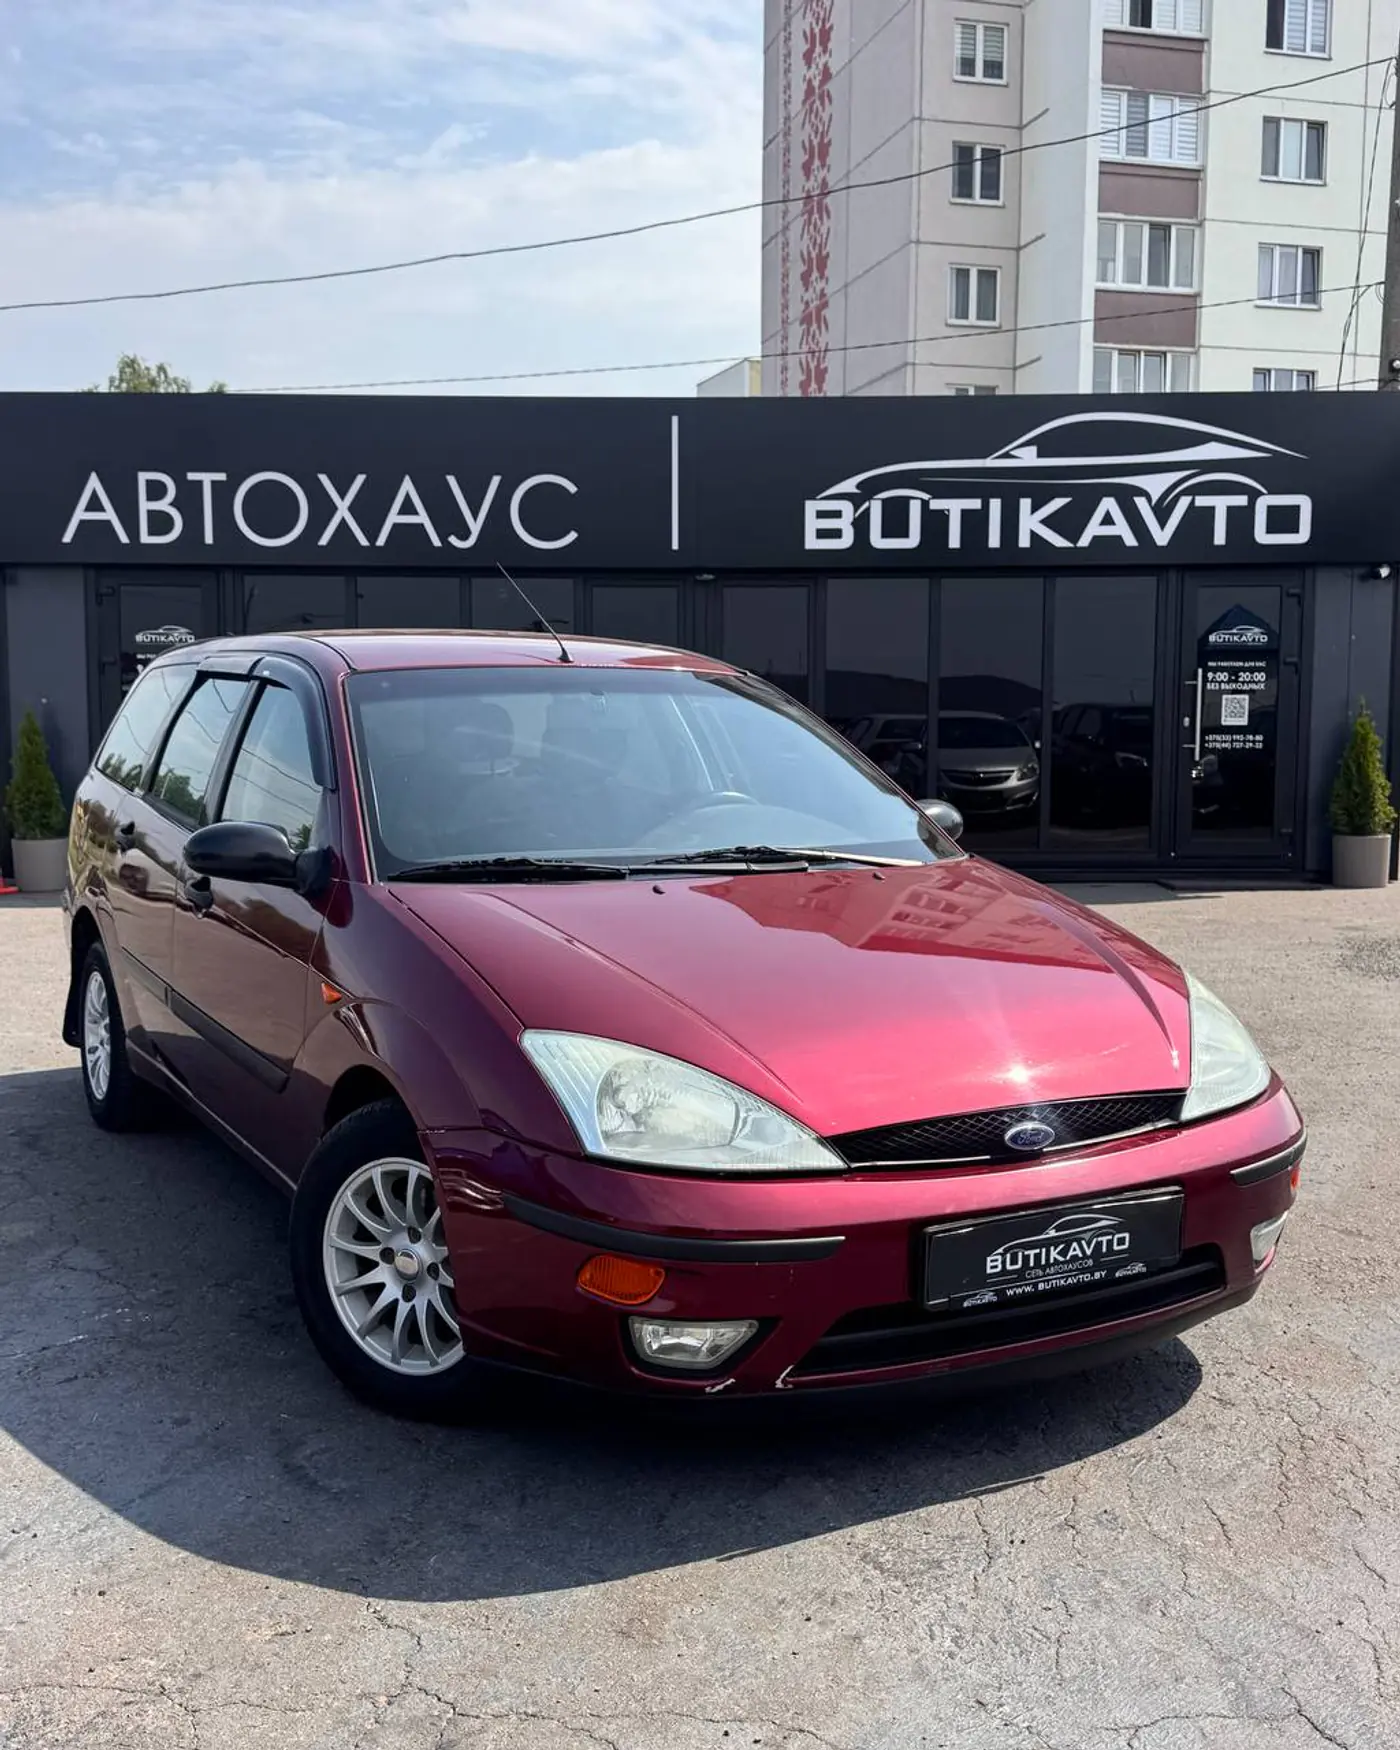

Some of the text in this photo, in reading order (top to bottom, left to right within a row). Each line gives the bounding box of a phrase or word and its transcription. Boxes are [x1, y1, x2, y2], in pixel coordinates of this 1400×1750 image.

[62, 470, 578, 549] АВТОХАУС
[804, 493, 1312, 550] BUTIKAVTO
[136, 634, 195, 642] BUTIKAVTO
[1209, 634, 1268, 642] BUTIKAVTO
[1207, 672, 1229, 681] 9:00
[1238, 672, 1266, 681] 20:00
[1221, 682, 1266, 690] ВЫХОДНЫХ
[986, 1232, 1130, 1274] BUTIKAVTO
[1025, 1259, 1094, 1279] СЕТЬ АВТОХАУСОВ
